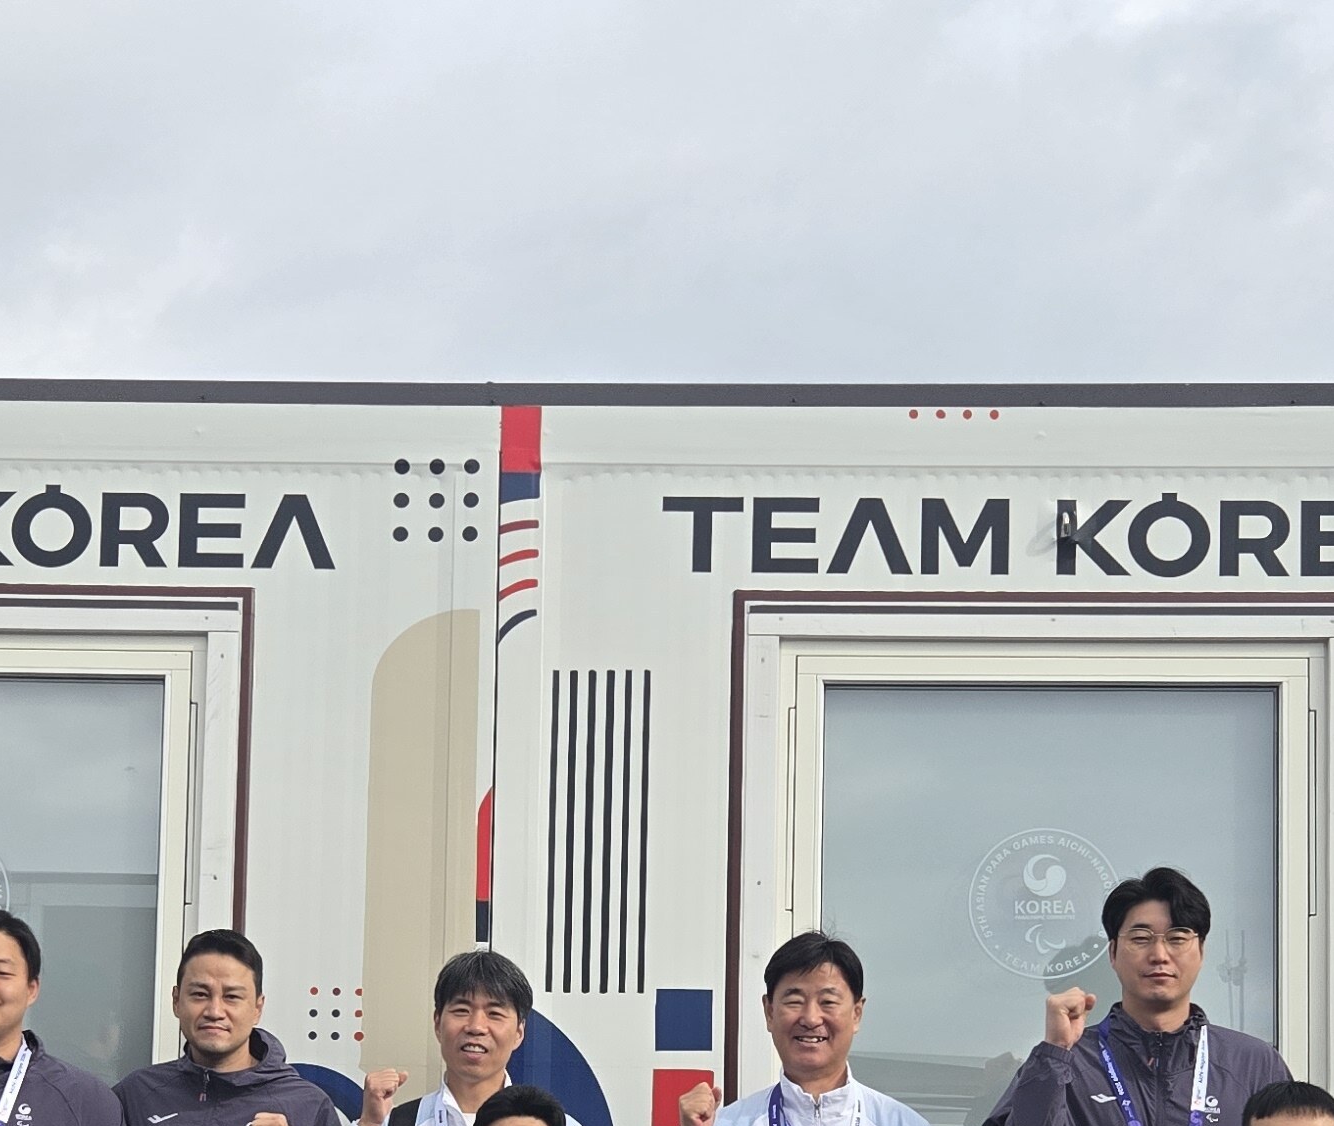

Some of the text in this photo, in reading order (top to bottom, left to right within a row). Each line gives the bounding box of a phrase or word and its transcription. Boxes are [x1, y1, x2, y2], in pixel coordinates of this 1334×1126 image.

[662, 496, 1009, 575] TEAM
[976, 876, 990, 912] ASIAN
[985, 848, 1011, 874] PARA
[1012, 835, 1054, 850] GAMES
[1014, 900, 1075, 914] KOREA
[1004, 952, 1090, 973] TEAM KOREA
